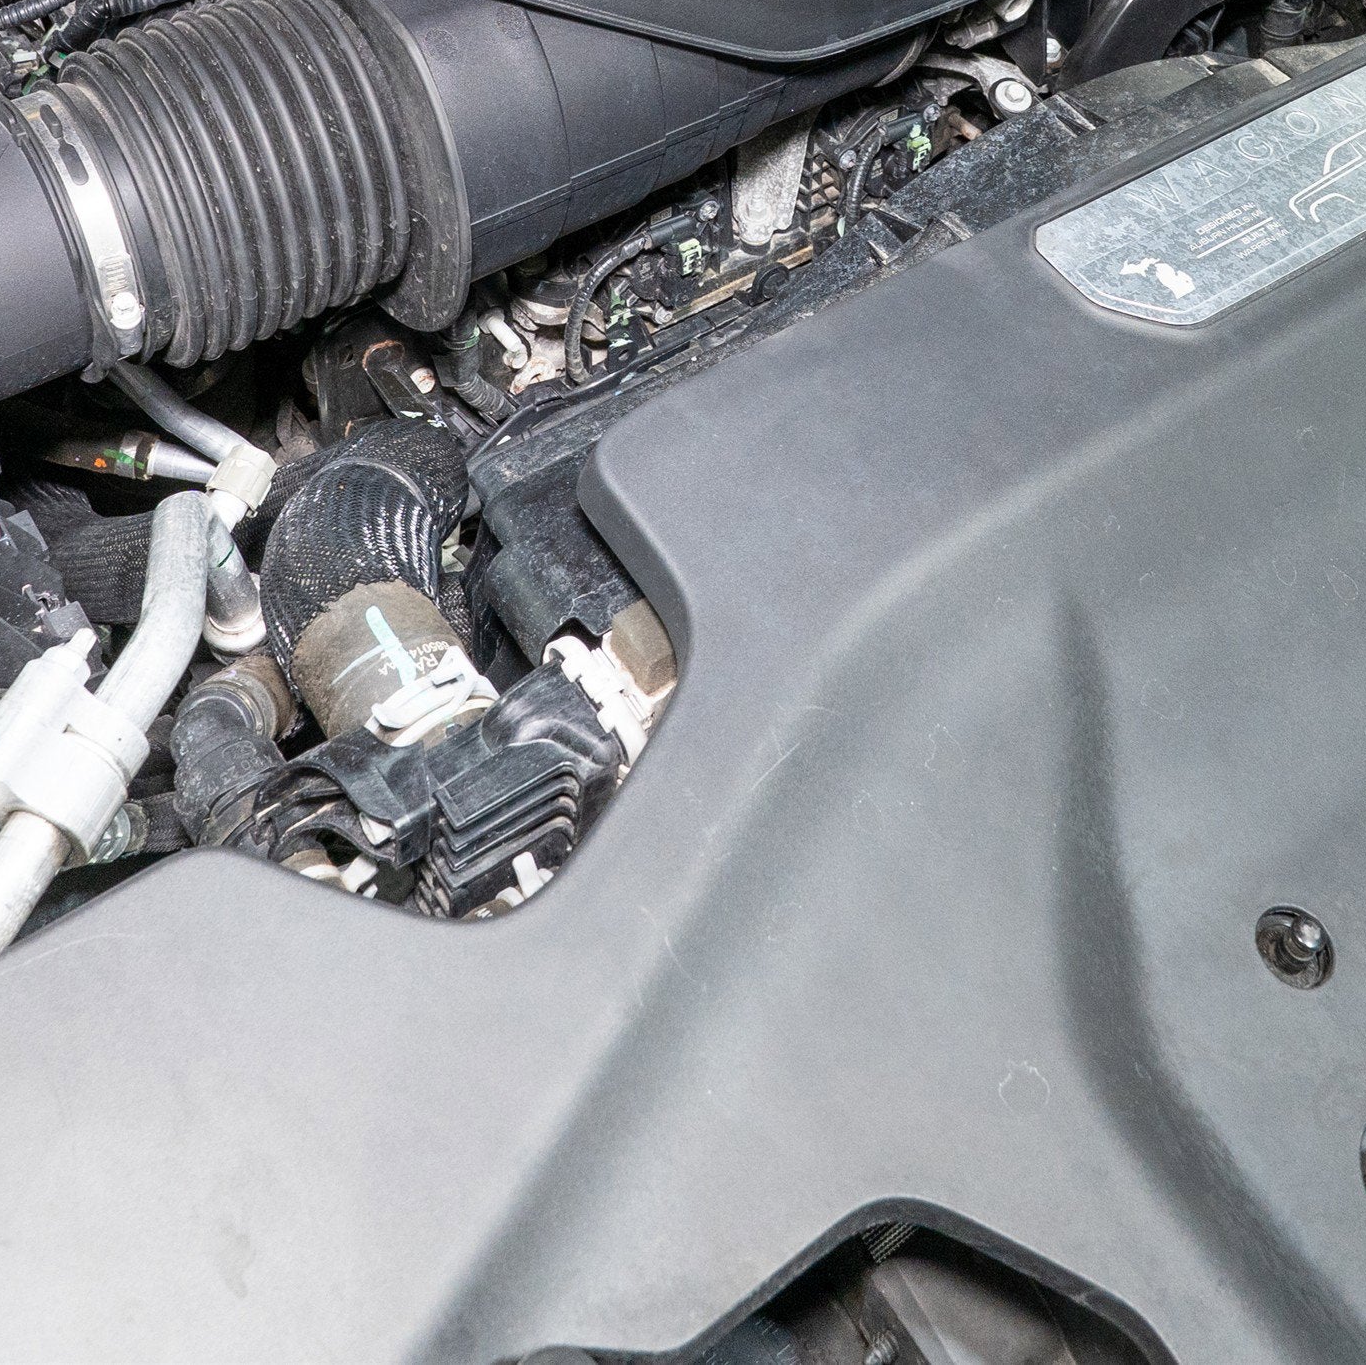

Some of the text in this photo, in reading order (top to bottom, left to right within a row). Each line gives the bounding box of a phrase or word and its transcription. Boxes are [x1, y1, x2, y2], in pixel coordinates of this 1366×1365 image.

[1195, 200, 1255, 236] DESIGNED IN:
[1188, 228, 1226, 252] AUBURN
[1240, 226, 1267, 245] BUILT
